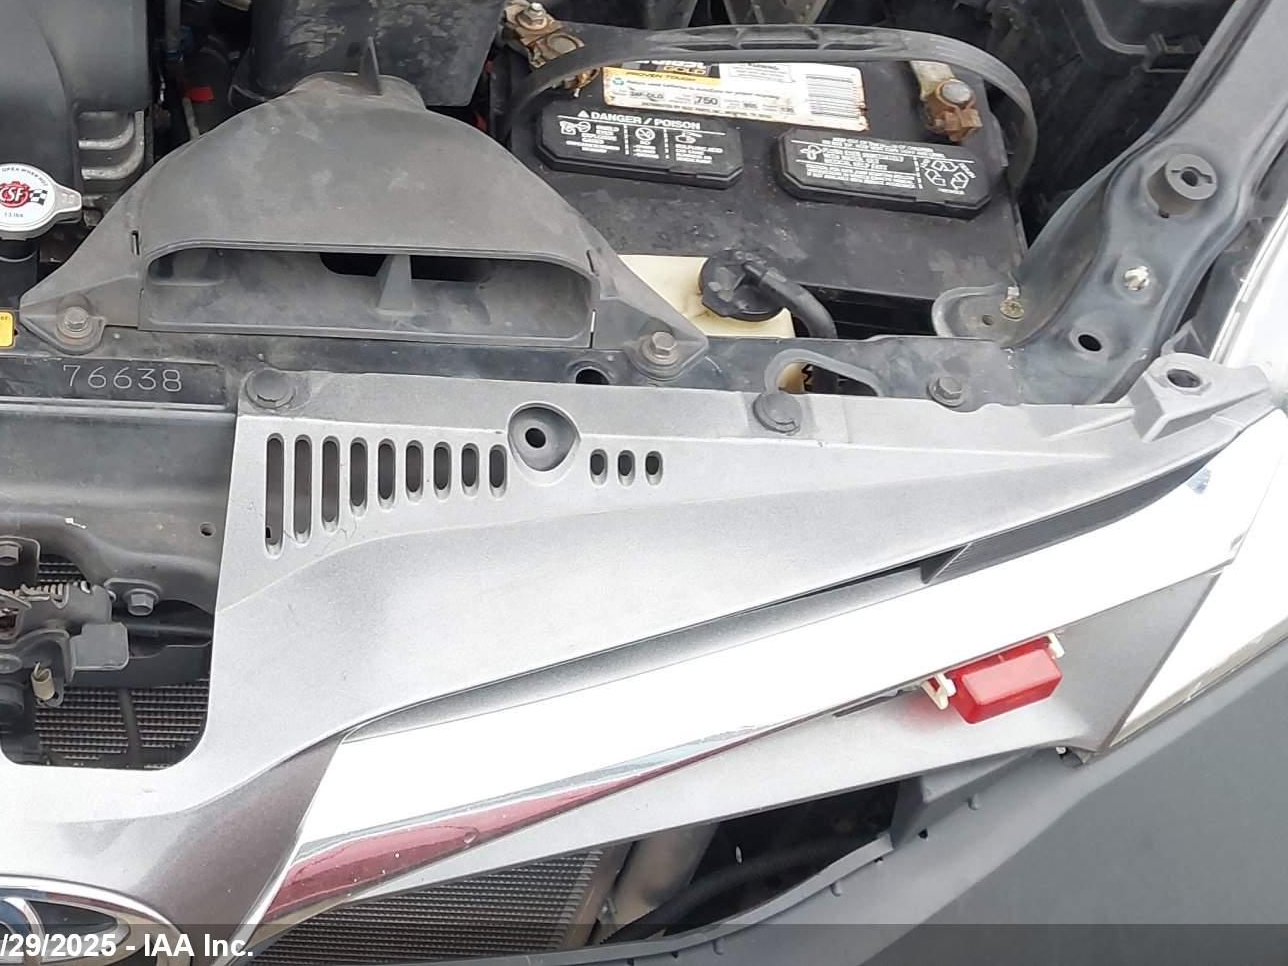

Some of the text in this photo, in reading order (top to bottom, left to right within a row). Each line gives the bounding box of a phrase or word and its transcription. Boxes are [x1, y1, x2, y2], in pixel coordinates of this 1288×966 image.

[663, 65, 706, 75] GOLD
[696, 95, 718, 106] 750
[591, 112, 701, 130] DANGER / POISON
[62, 364, 183, 392] 76638
